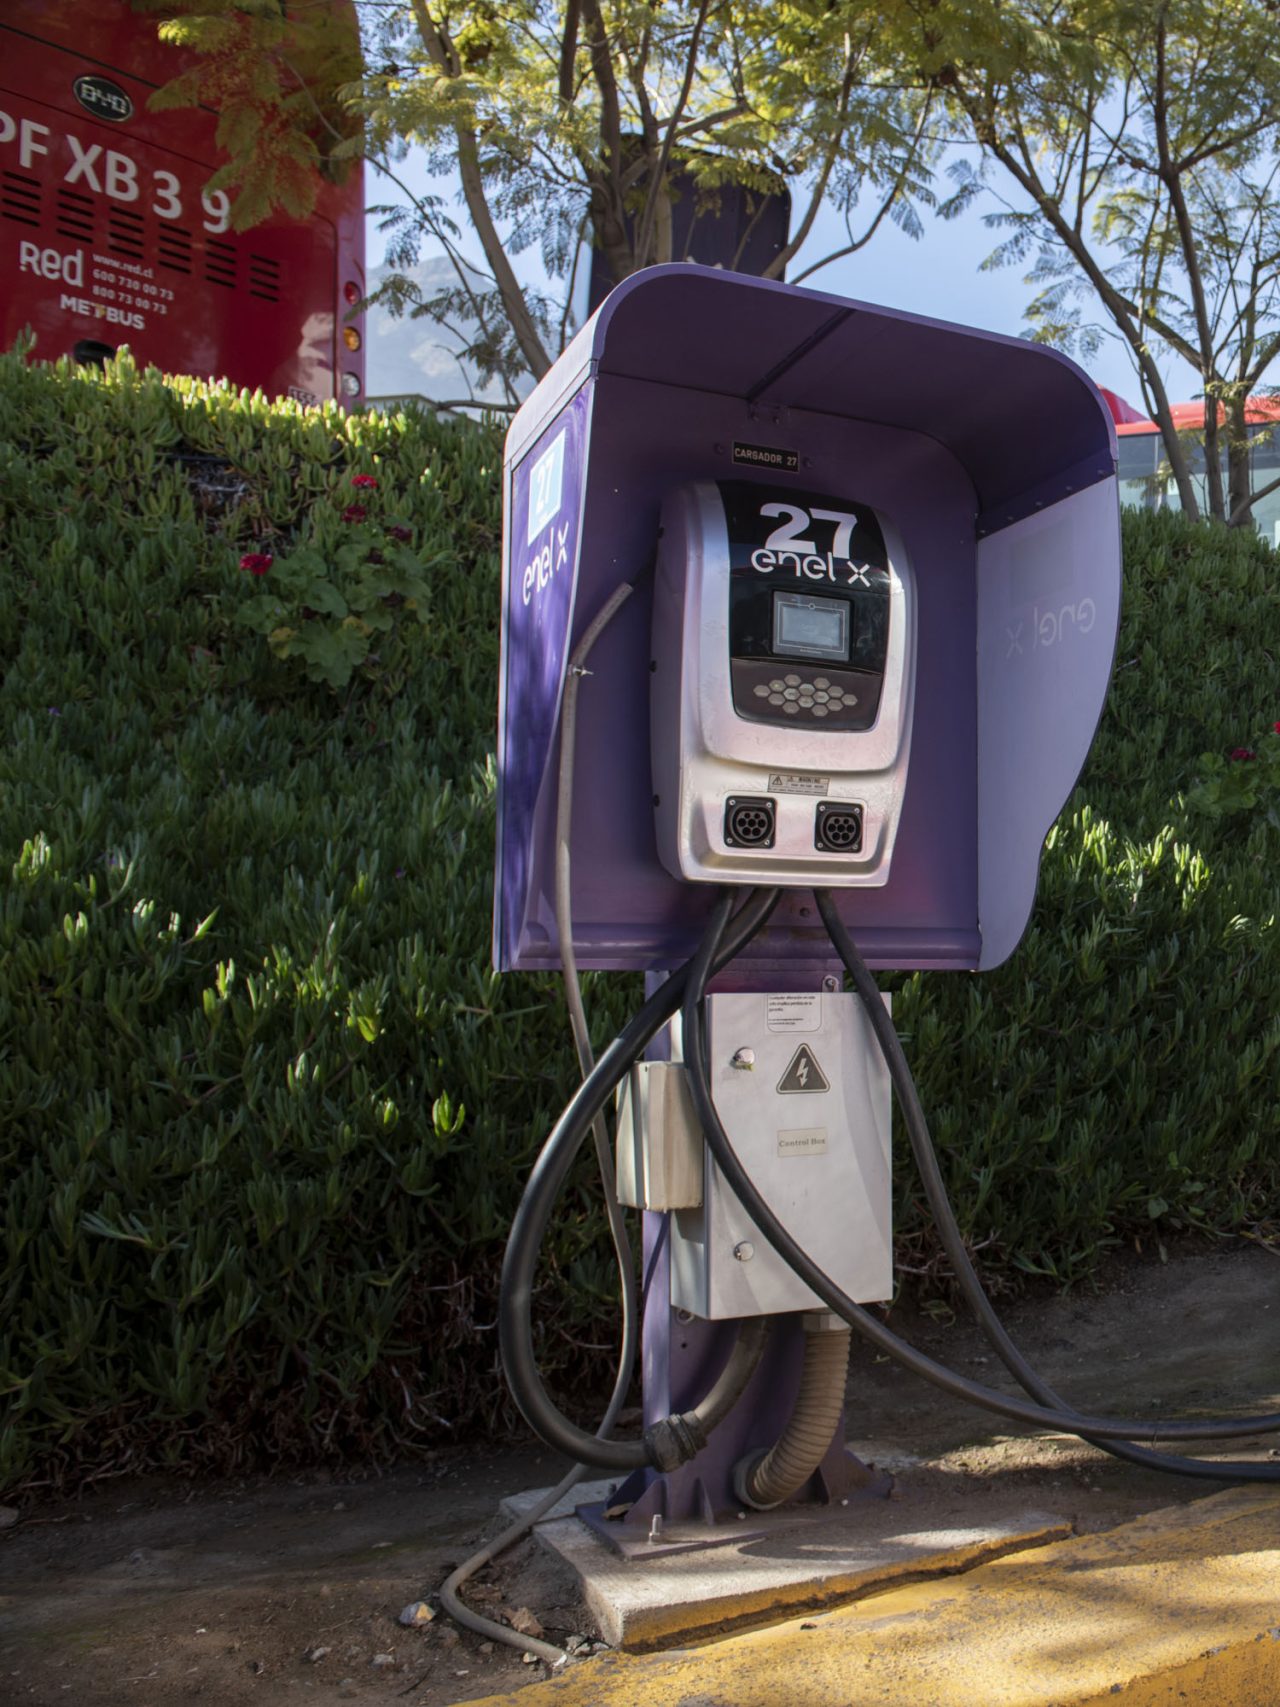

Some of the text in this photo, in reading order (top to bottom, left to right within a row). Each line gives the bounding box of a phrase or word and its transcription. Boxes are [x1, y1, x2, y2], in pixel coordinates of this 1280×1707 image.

[80, 82, 127, 115] BYD
[19, 241, 83, 287] Red
[92, 253, 154, 279] www.red.cl
[92, 268, 116, 284] 600
[734, 447, 797, 467] CARGADOR 27
[760, 502, 858, 560] 27
[523, 527, 554, 606] enel
[751, 548, 837, 583] enel
